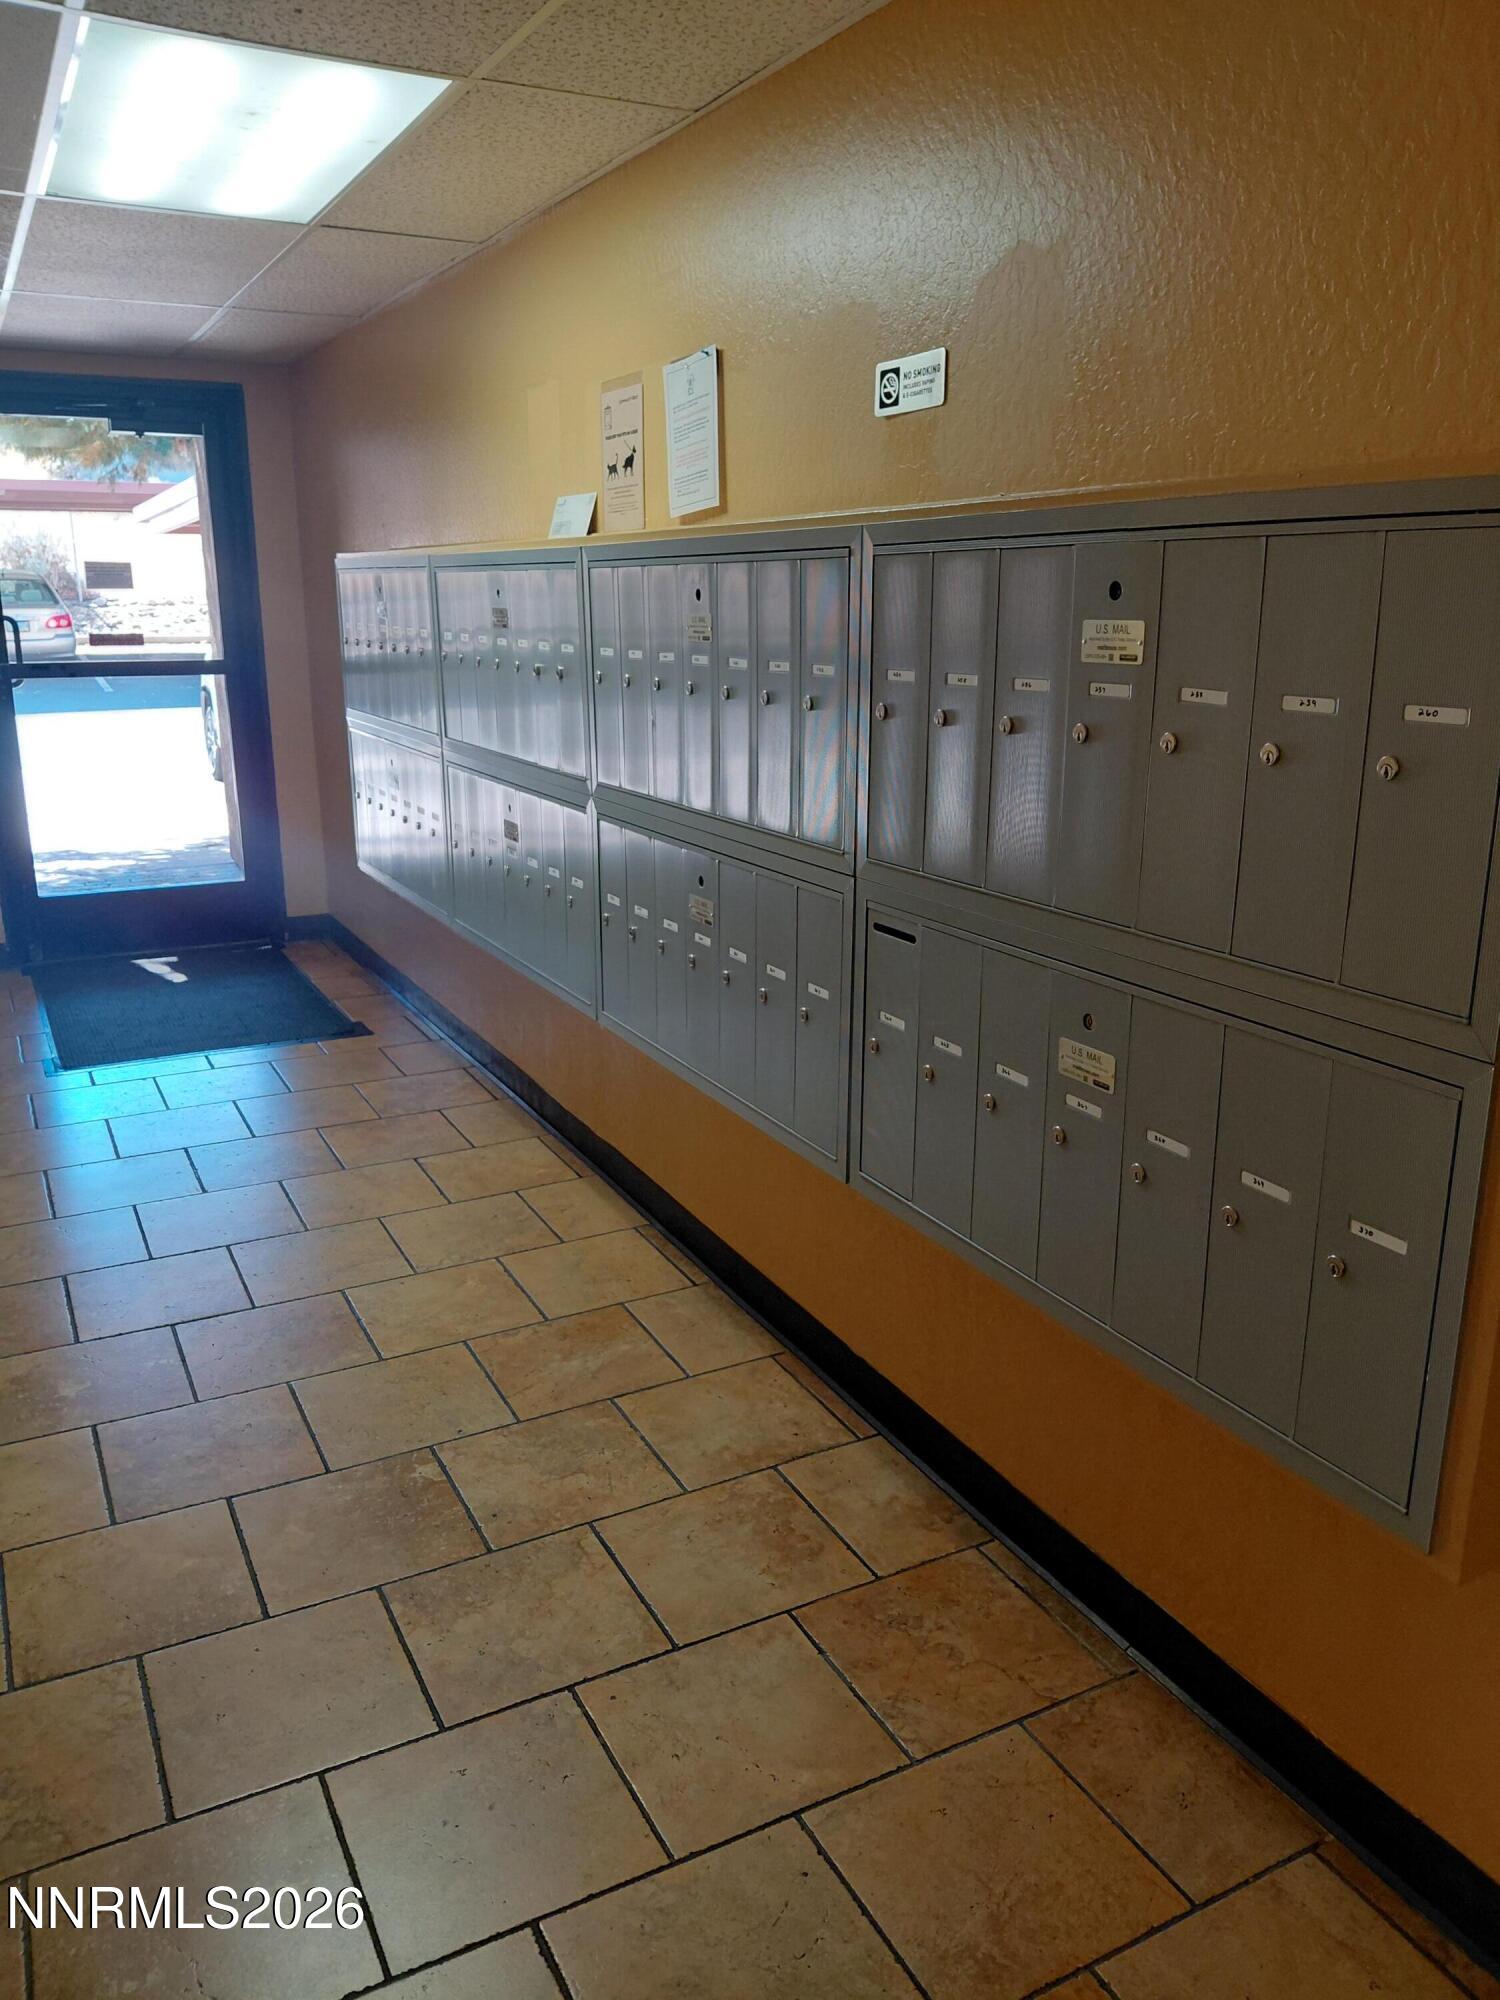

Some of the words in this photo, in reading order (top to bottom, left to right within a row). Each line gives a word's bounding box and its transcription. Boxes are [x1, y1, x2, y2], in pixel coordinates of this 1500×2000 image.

[903, 371, 912, 380] NO
[913, 363, 941, 378] SMOKING
[1112, 624, 1132, 635] MAIL
[1418, 708, 1439, 718] 260
[1086, 1051, 1103, 1065] MAIL
[1359, 1226, 1374, 1237] 370
